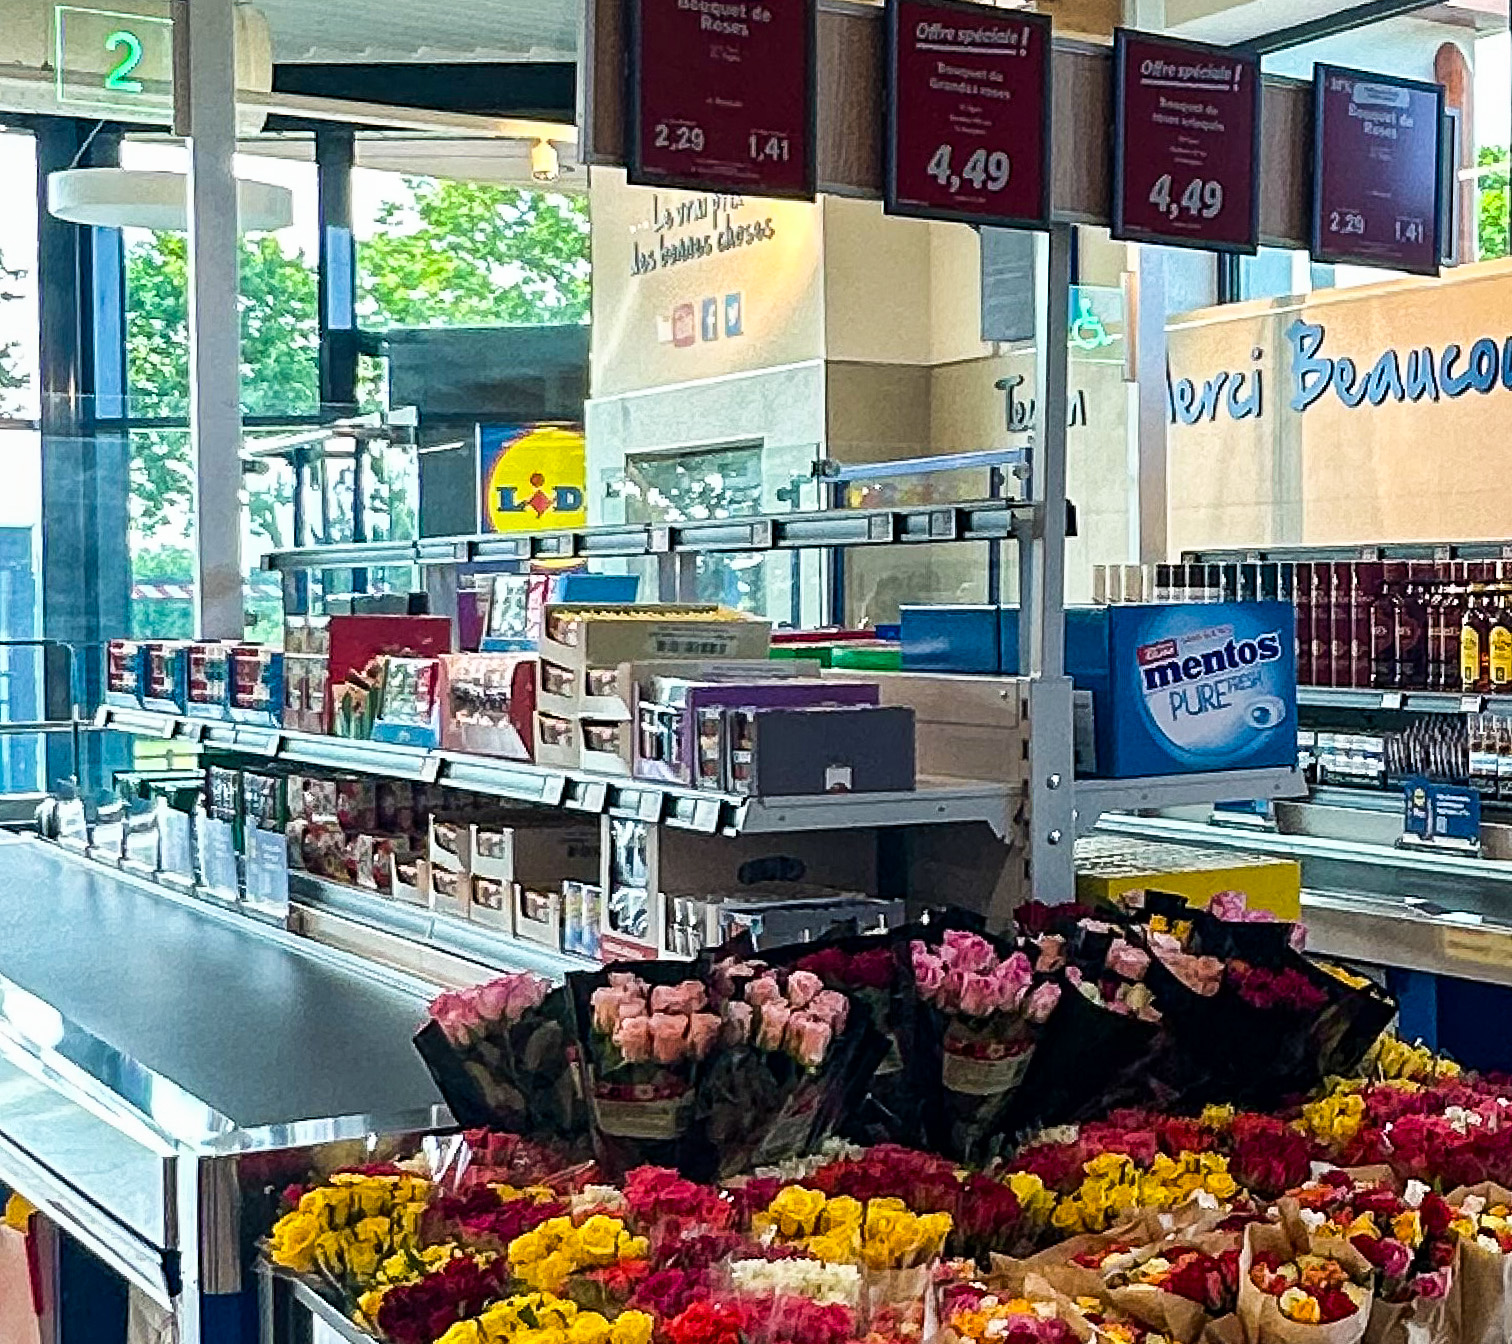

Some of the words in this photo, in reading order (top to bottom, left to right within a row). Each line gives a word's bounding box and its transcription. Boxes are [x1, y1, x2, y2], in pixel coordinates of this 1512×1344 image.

[701, 16, 749, 37] Roses
[752, 6, 773, 22] de
[917, 22, 956, 41] Offre
[105, 31, 143, 92] 2
[1141, 60, 1176, 77] Offre
[654, 124, 704, 152] 2,29
[749, 133, 790, 161] 1,41
[927, 144, 1010, 192] 4,49
[1149, 174, 1223, 220] 4,49
[1166, 346, 1263, 425] erci
[1143, 632, 1282, 691] mentos
[1169, 678, 1232, 721] PURE
